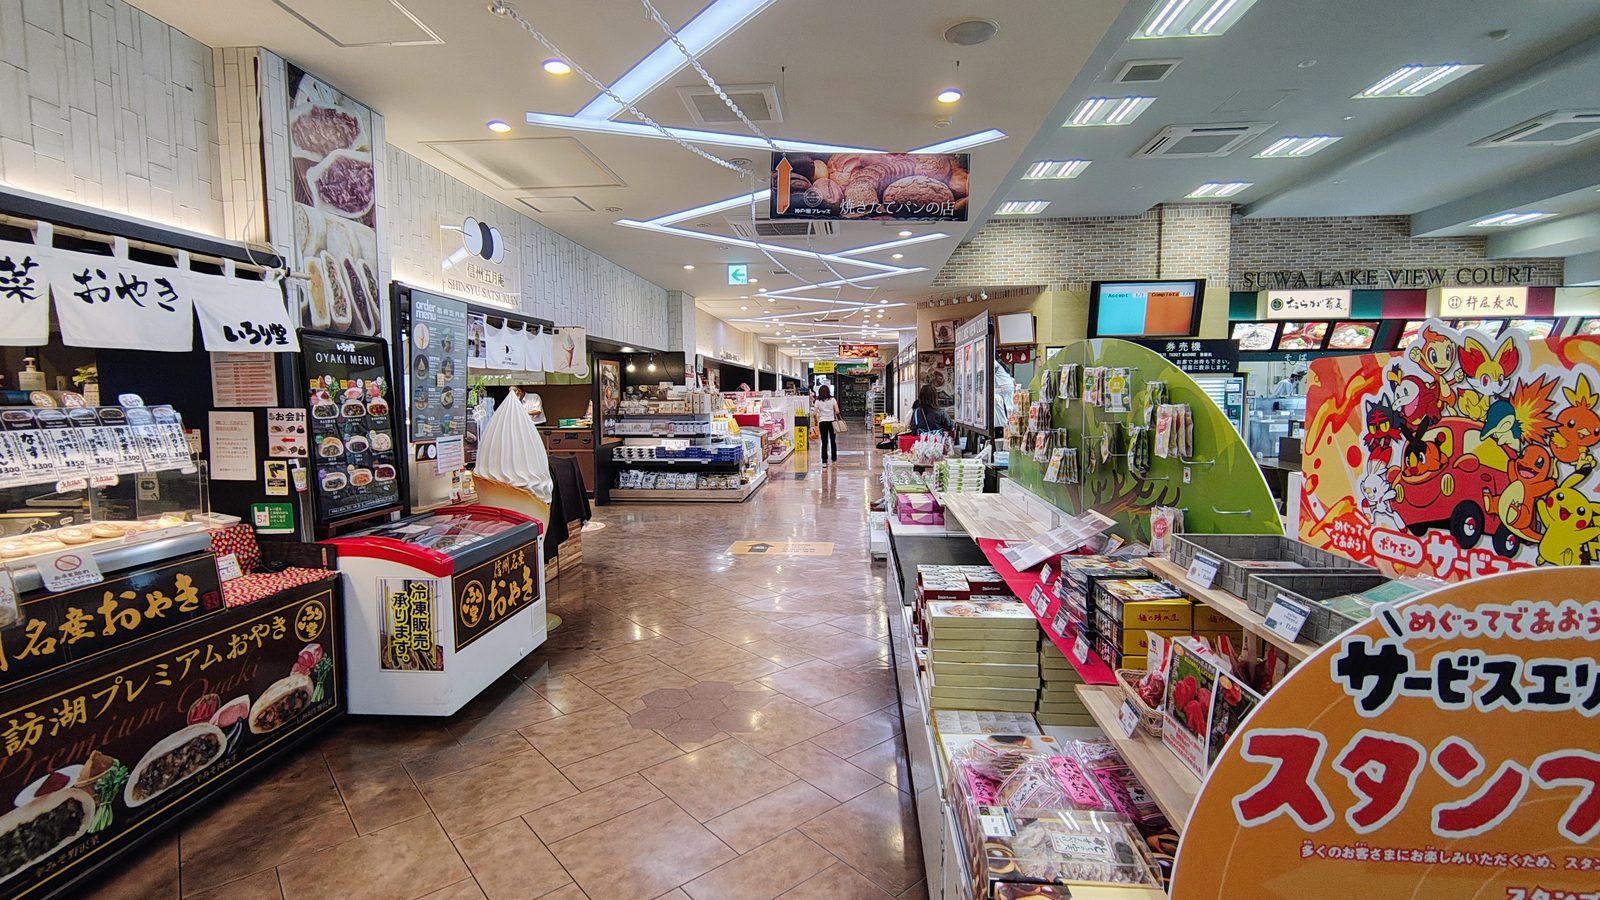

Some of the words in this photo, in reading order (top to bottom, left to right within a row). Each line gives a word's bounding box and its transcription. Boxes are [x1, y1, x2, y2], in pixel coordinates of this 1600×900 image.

[839, 198, 955, 217] 焼きたてパンの店
[467, 262, 505, 288] 信州五月庵
[1243, 271, 1309, 288] SUWA
[1317, 269, 1379, 287] LAKE
[1387, 268, 1447, 286] VIEW
[1456, 266, 1538, 285] COURT
[73, 268, 178, 312] おやき
[447, 279, 480, 296] SHINSYU
[481, 288, 519, 306] SATSUKIAN
[416, 300, 436, 312] order
[416, 310, 436, 320] menu
[1286, 297, 1344, 310] おらが蕎麦
[223, 321, 290, 346] いろり堂
[1166, 341, 1201, 352] 券売機
[315, 352, 346, 364] OYAKI
[350, 355, 376, 366] MENU
[1284, 353, 1307, 361] そば
[275, 412, 305, 421] お会計
[20, 433, 38, 459] なす
[1334, 520, 1363, 535] めぐって
[1379, 535, 1416, 558] ポケモン
[1428, 535, 1526, 579] サービス
[487, 564, 534, 622] おやき
[0, 572, 200, 671] 名産おやき
[391, 591, 411, 662] 承ります。
[410, 582, 430, 650] 冷凍販売
[1408, 606, 1600, 634] めぐってであおう
[1, 615, 287, 757] 訪湖プレミアムおやき
[1337, 640, 1600, 712] サービスエリ
[1302, 843, 1557, 869] 多くのお客さまにお楽しみいただくため、
